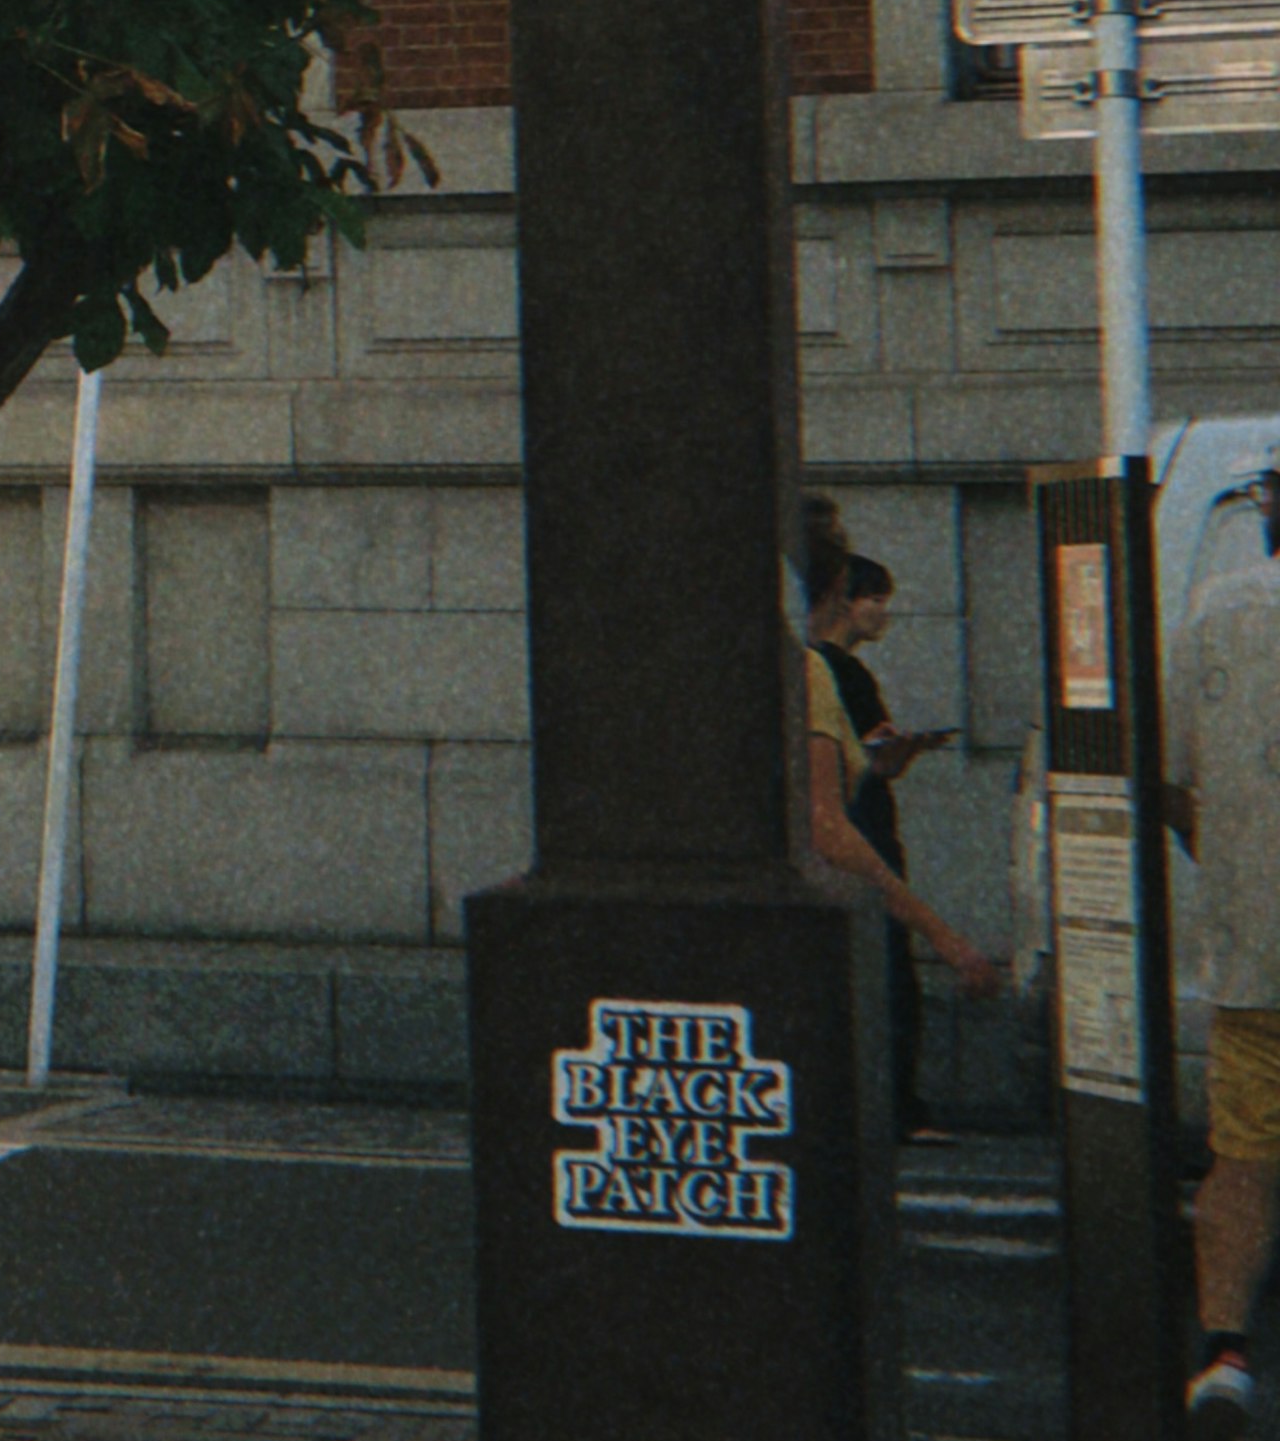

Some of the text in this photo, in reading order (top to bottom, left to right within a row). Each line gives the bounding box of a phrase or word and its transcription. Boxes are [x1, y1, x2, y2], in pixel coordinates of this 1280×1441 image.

[604, 1013, 737, 1064] THE
[567, 1064, 773, 1119] BLACK
[612, 1117, 730, 1164] EYE
[567, 1162, 773, 1220] PATCH
